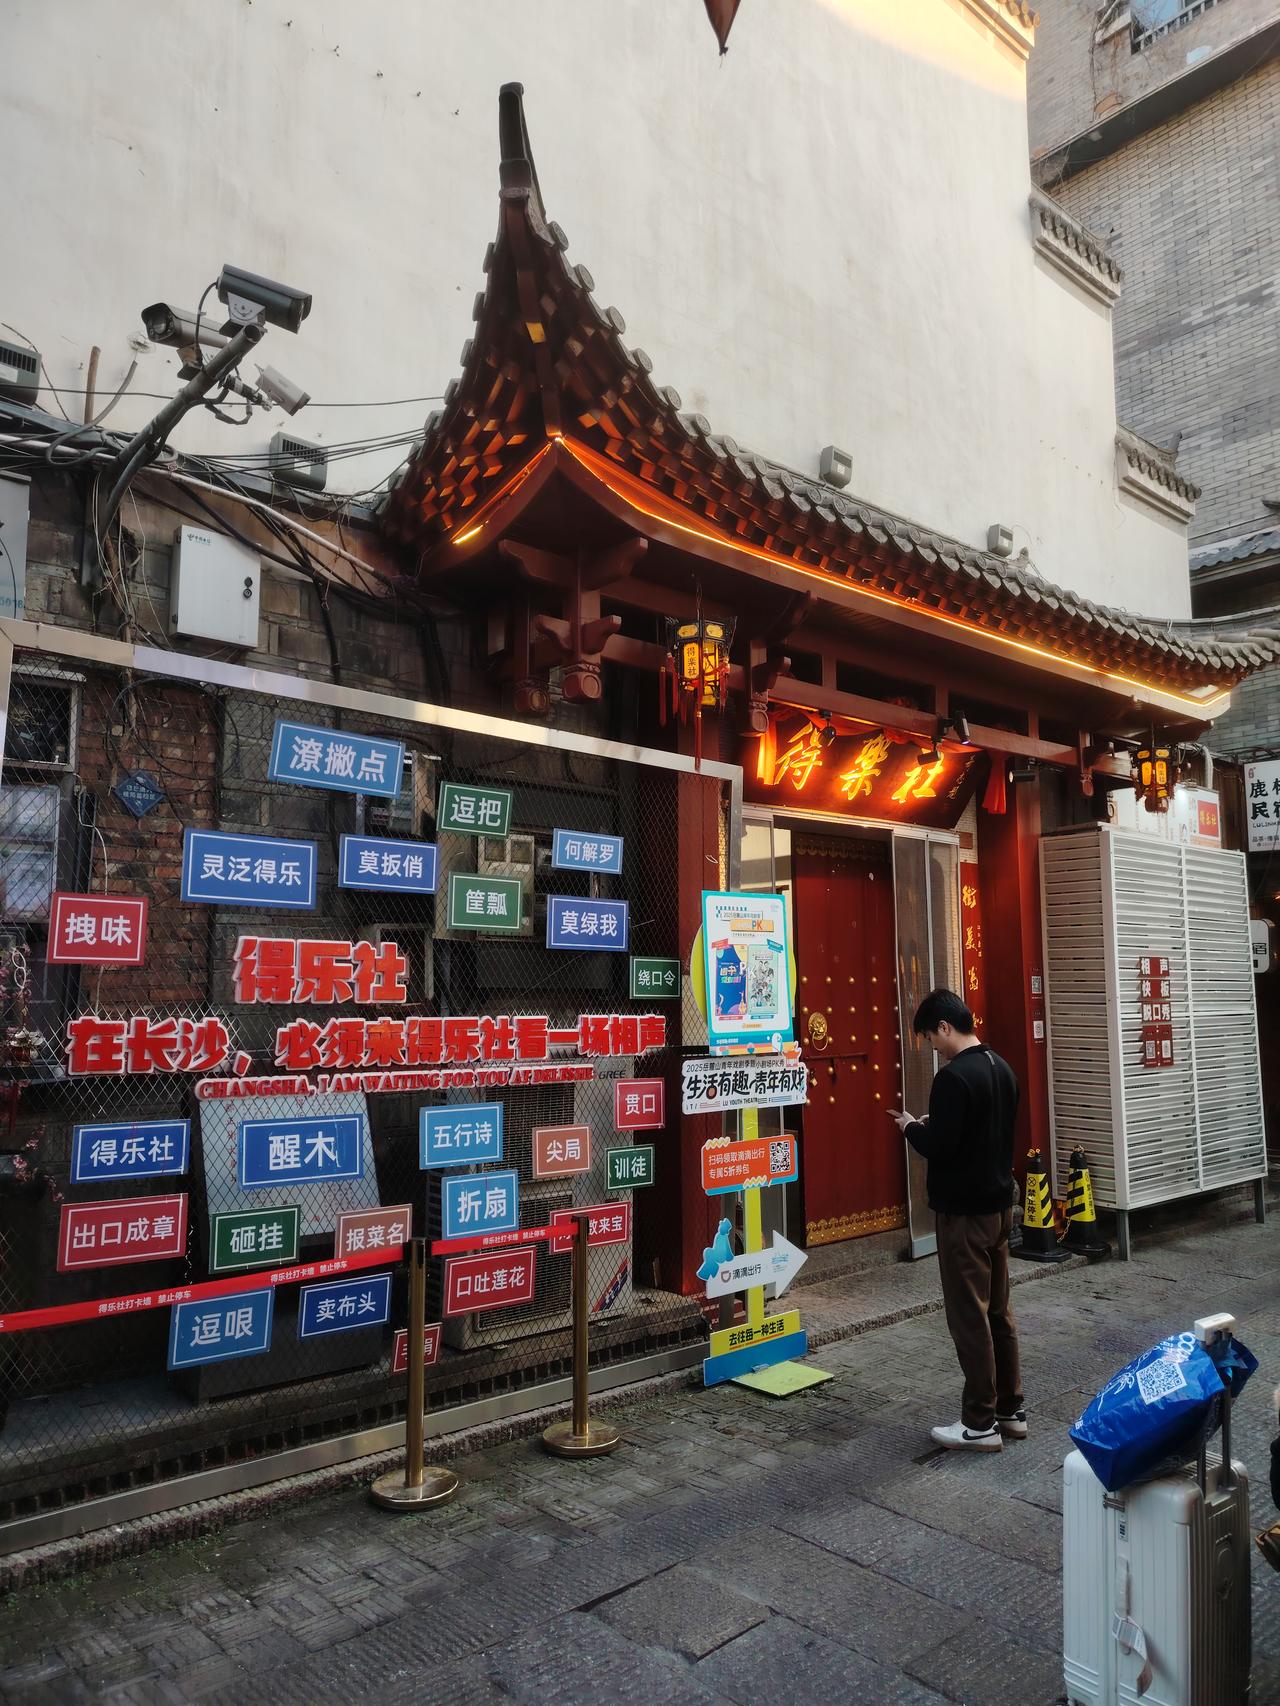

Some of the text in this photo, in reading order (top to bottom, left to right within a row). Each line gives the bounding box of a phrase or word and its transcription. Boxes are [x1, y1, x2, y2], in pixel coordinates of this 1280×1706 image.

[289, 735, 388, 785] 潦撇点
[449, 794, 502, 828] 逗把
[357, 850, 424, 880] 莫扳俏
[564, 839, 616, 865] 何解罗
[200, 853, 302, 887] 灵泛得乐
[465, 888, 508, 917] 筐瓢
[64, 912, 133, 947] 拽味
[560, 910, 618, 938] 莫绿我
[233, 935, 407, 1005] 得乐社
[637, 968, 676, 988] 绕口令
[1140, 957, 1169, 975] 相声
[1141, 980, 1170, 998] 快板
[1143, 1003, 1171, 1021] 脱口秀
[195, 1075, 317, 1100] CHANGSHA,
[317, 1073, 331, 1094] I
[332, 1072, 362, 1094] AM
[362, 1069, 440, 1093] WAITING
[441, 1068, 476, 1089] FOR
[476, 1067, 511, 1087] YOU
[511, 1066, 531, 1085] AT
[600, 1070, 626, 1080] GREE
[624, 1093, 657, 1116] 贯口
[432, 1120, 493, 1149] 五行诗
[89, 1134, 175, 1168] 得乐社
[268, 1130, 338, 1172] 醒木
[545, 1138, 581, 1163] 尖局
[708, 1147, 766, 1166] 扫码领取滴滴出行
[613, 1155, 647, 1180] 训徒
[708, 1163, 750, 1180] 专属5折券包
[456, 1186, 507, 1224] 折扇
[72, 1215, 176, 1249] 出口成章
[229, 1221, 284, 1255] 砸挂
[345, 1222, 405, 1253] 报菜名
[522, 1229, 546, 1240] 禁止停车
[319, 1260, 348, 1274] 禁止停车
[732, 1263, 762, 1280] 滴滴出行
[455, 1265, 526, 1299] 口吐莲花
[157, 1290, 192, 1304] 禁止停车
[316, 1291, 377, 1324] 卖布头
[189, 1306, 255, 1349] 逗哏
[728, 1318, 785, 1347] 去往每一种生活
